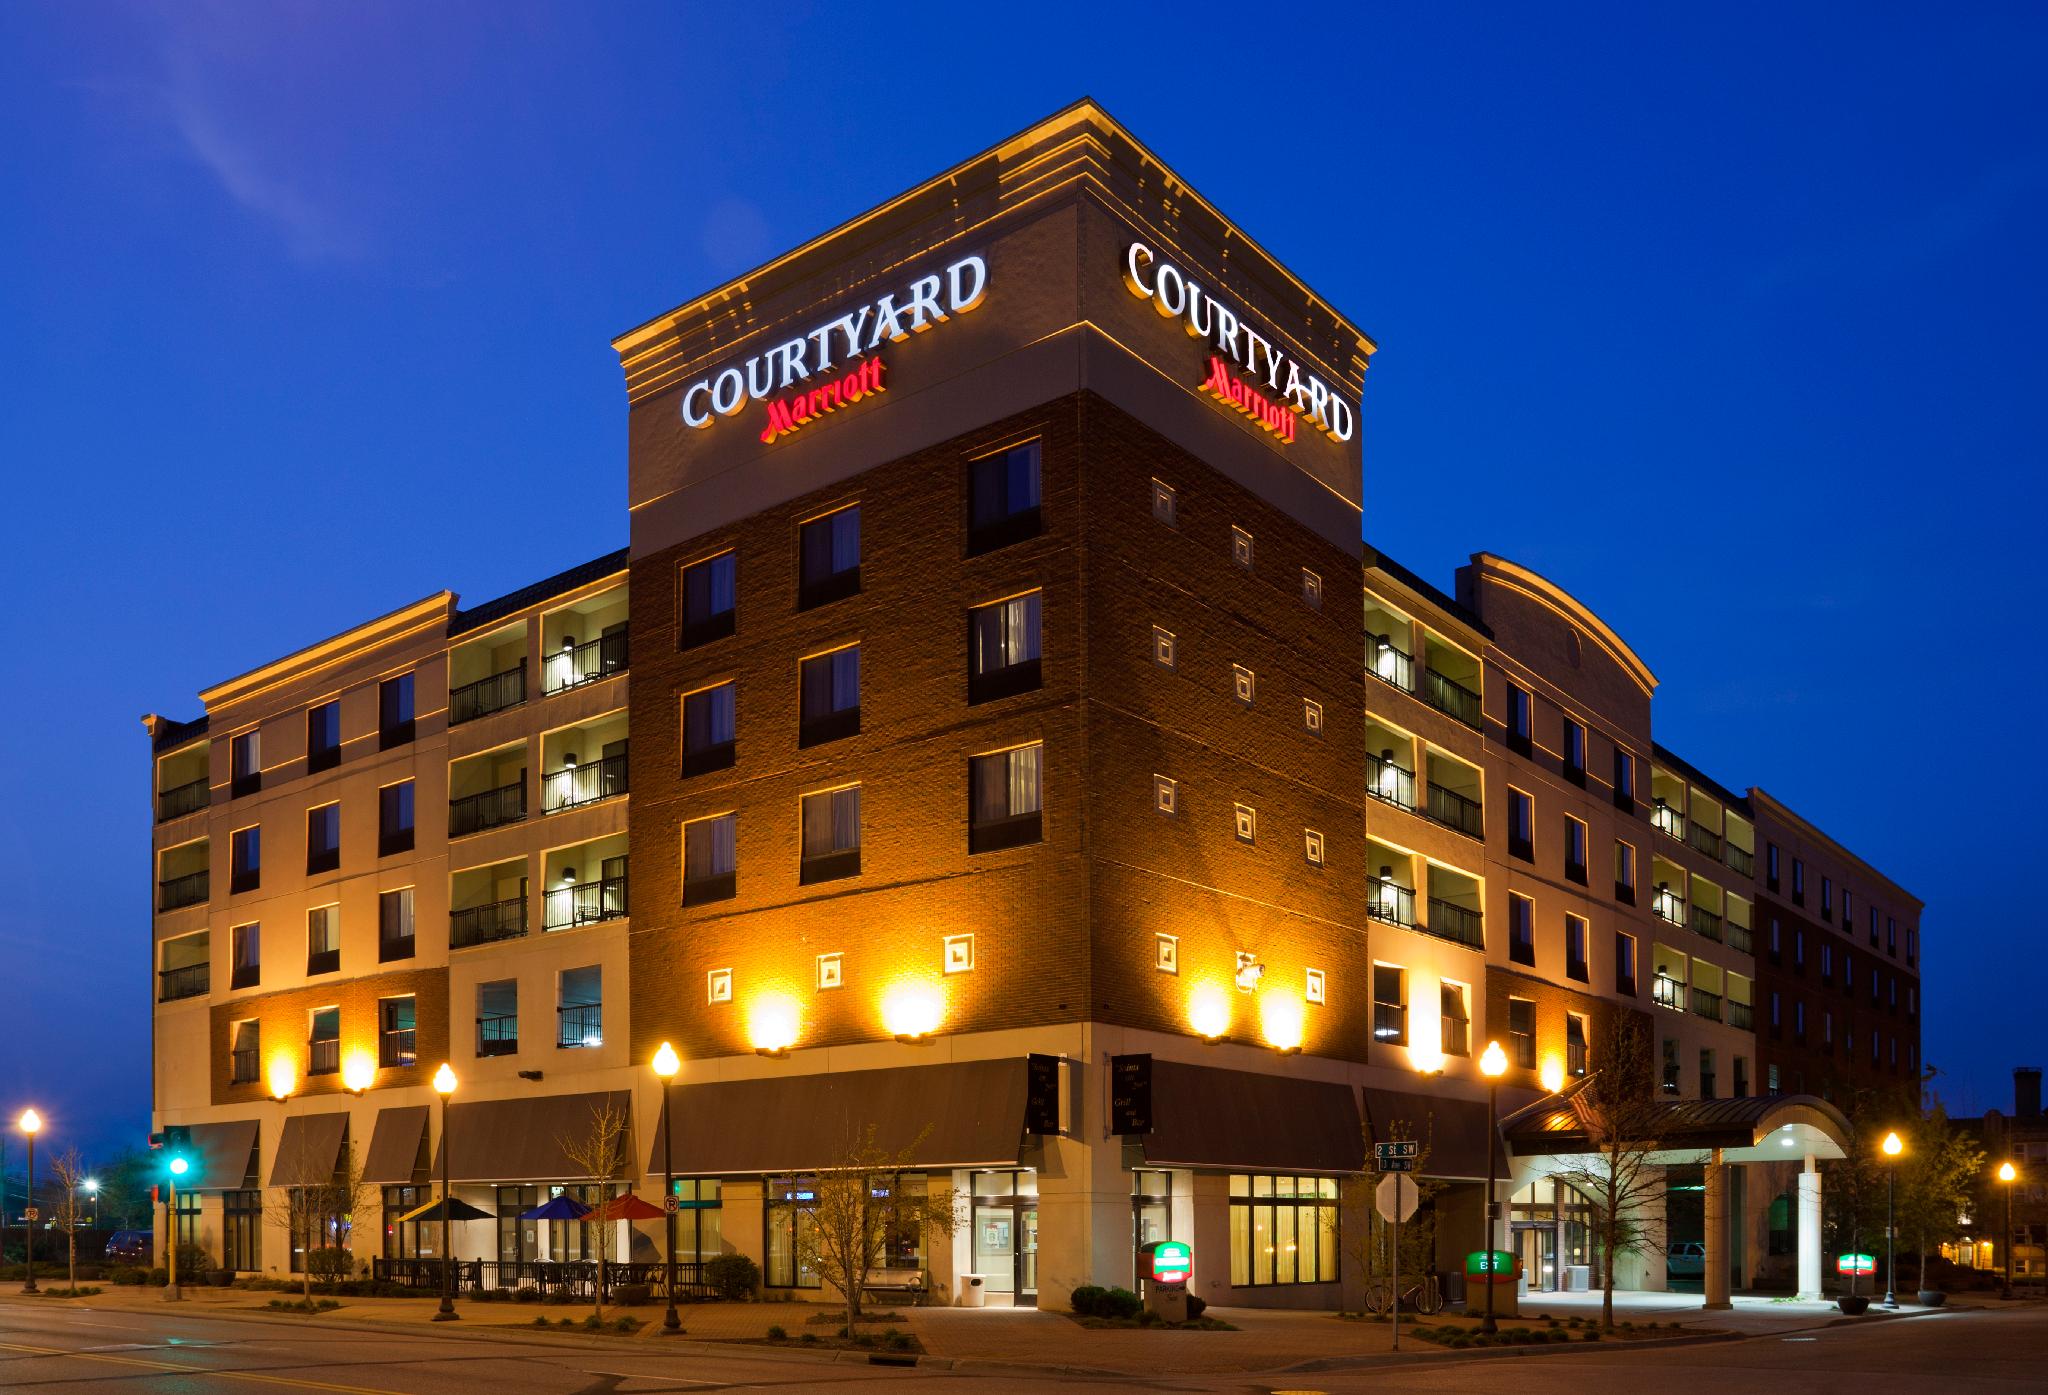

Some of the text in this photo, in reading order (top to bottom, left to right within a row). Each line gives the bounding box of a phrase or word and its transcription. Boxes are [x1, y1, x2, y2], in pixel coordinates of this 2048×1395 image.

[682, 256, 986, 428] COURTYARD
[1128, 242, 1353, 441] COURTYARD
[760, 356, 883, 443] Marriott
[1205, 357, 1296, 441] Marriott
[1377, 1145, 1383, 1156] 2
[1402, 1144, 1415, 1155] SW
[1480, 1261, 1499, 1270] ET
